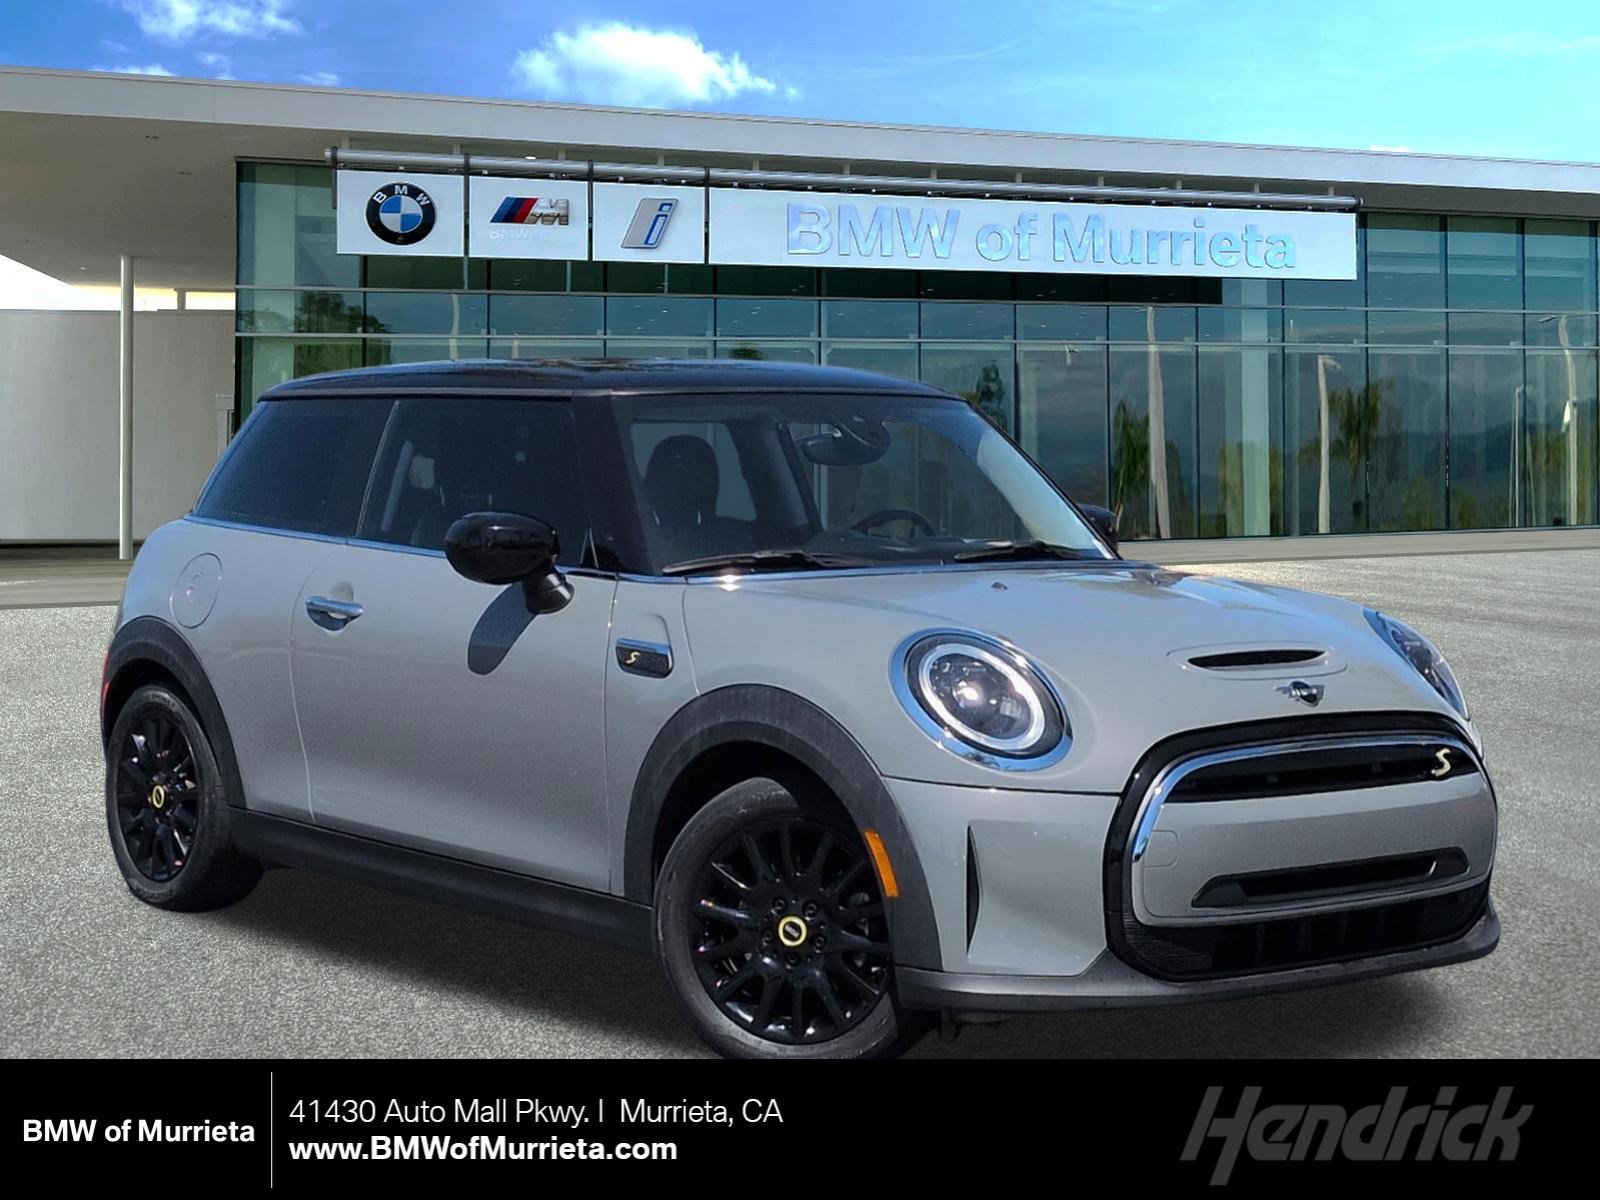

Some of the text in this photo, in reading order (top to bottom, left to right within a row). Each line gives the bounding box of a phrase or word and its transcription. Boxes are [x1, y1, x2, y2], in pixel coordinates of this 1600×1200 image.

[372, 184, 431, 206] BMW
[786, 202, 1296, 270] BMW of Murrieta
[625, 651, 641, 665] S
[1431, 747, 1452, 778] S
